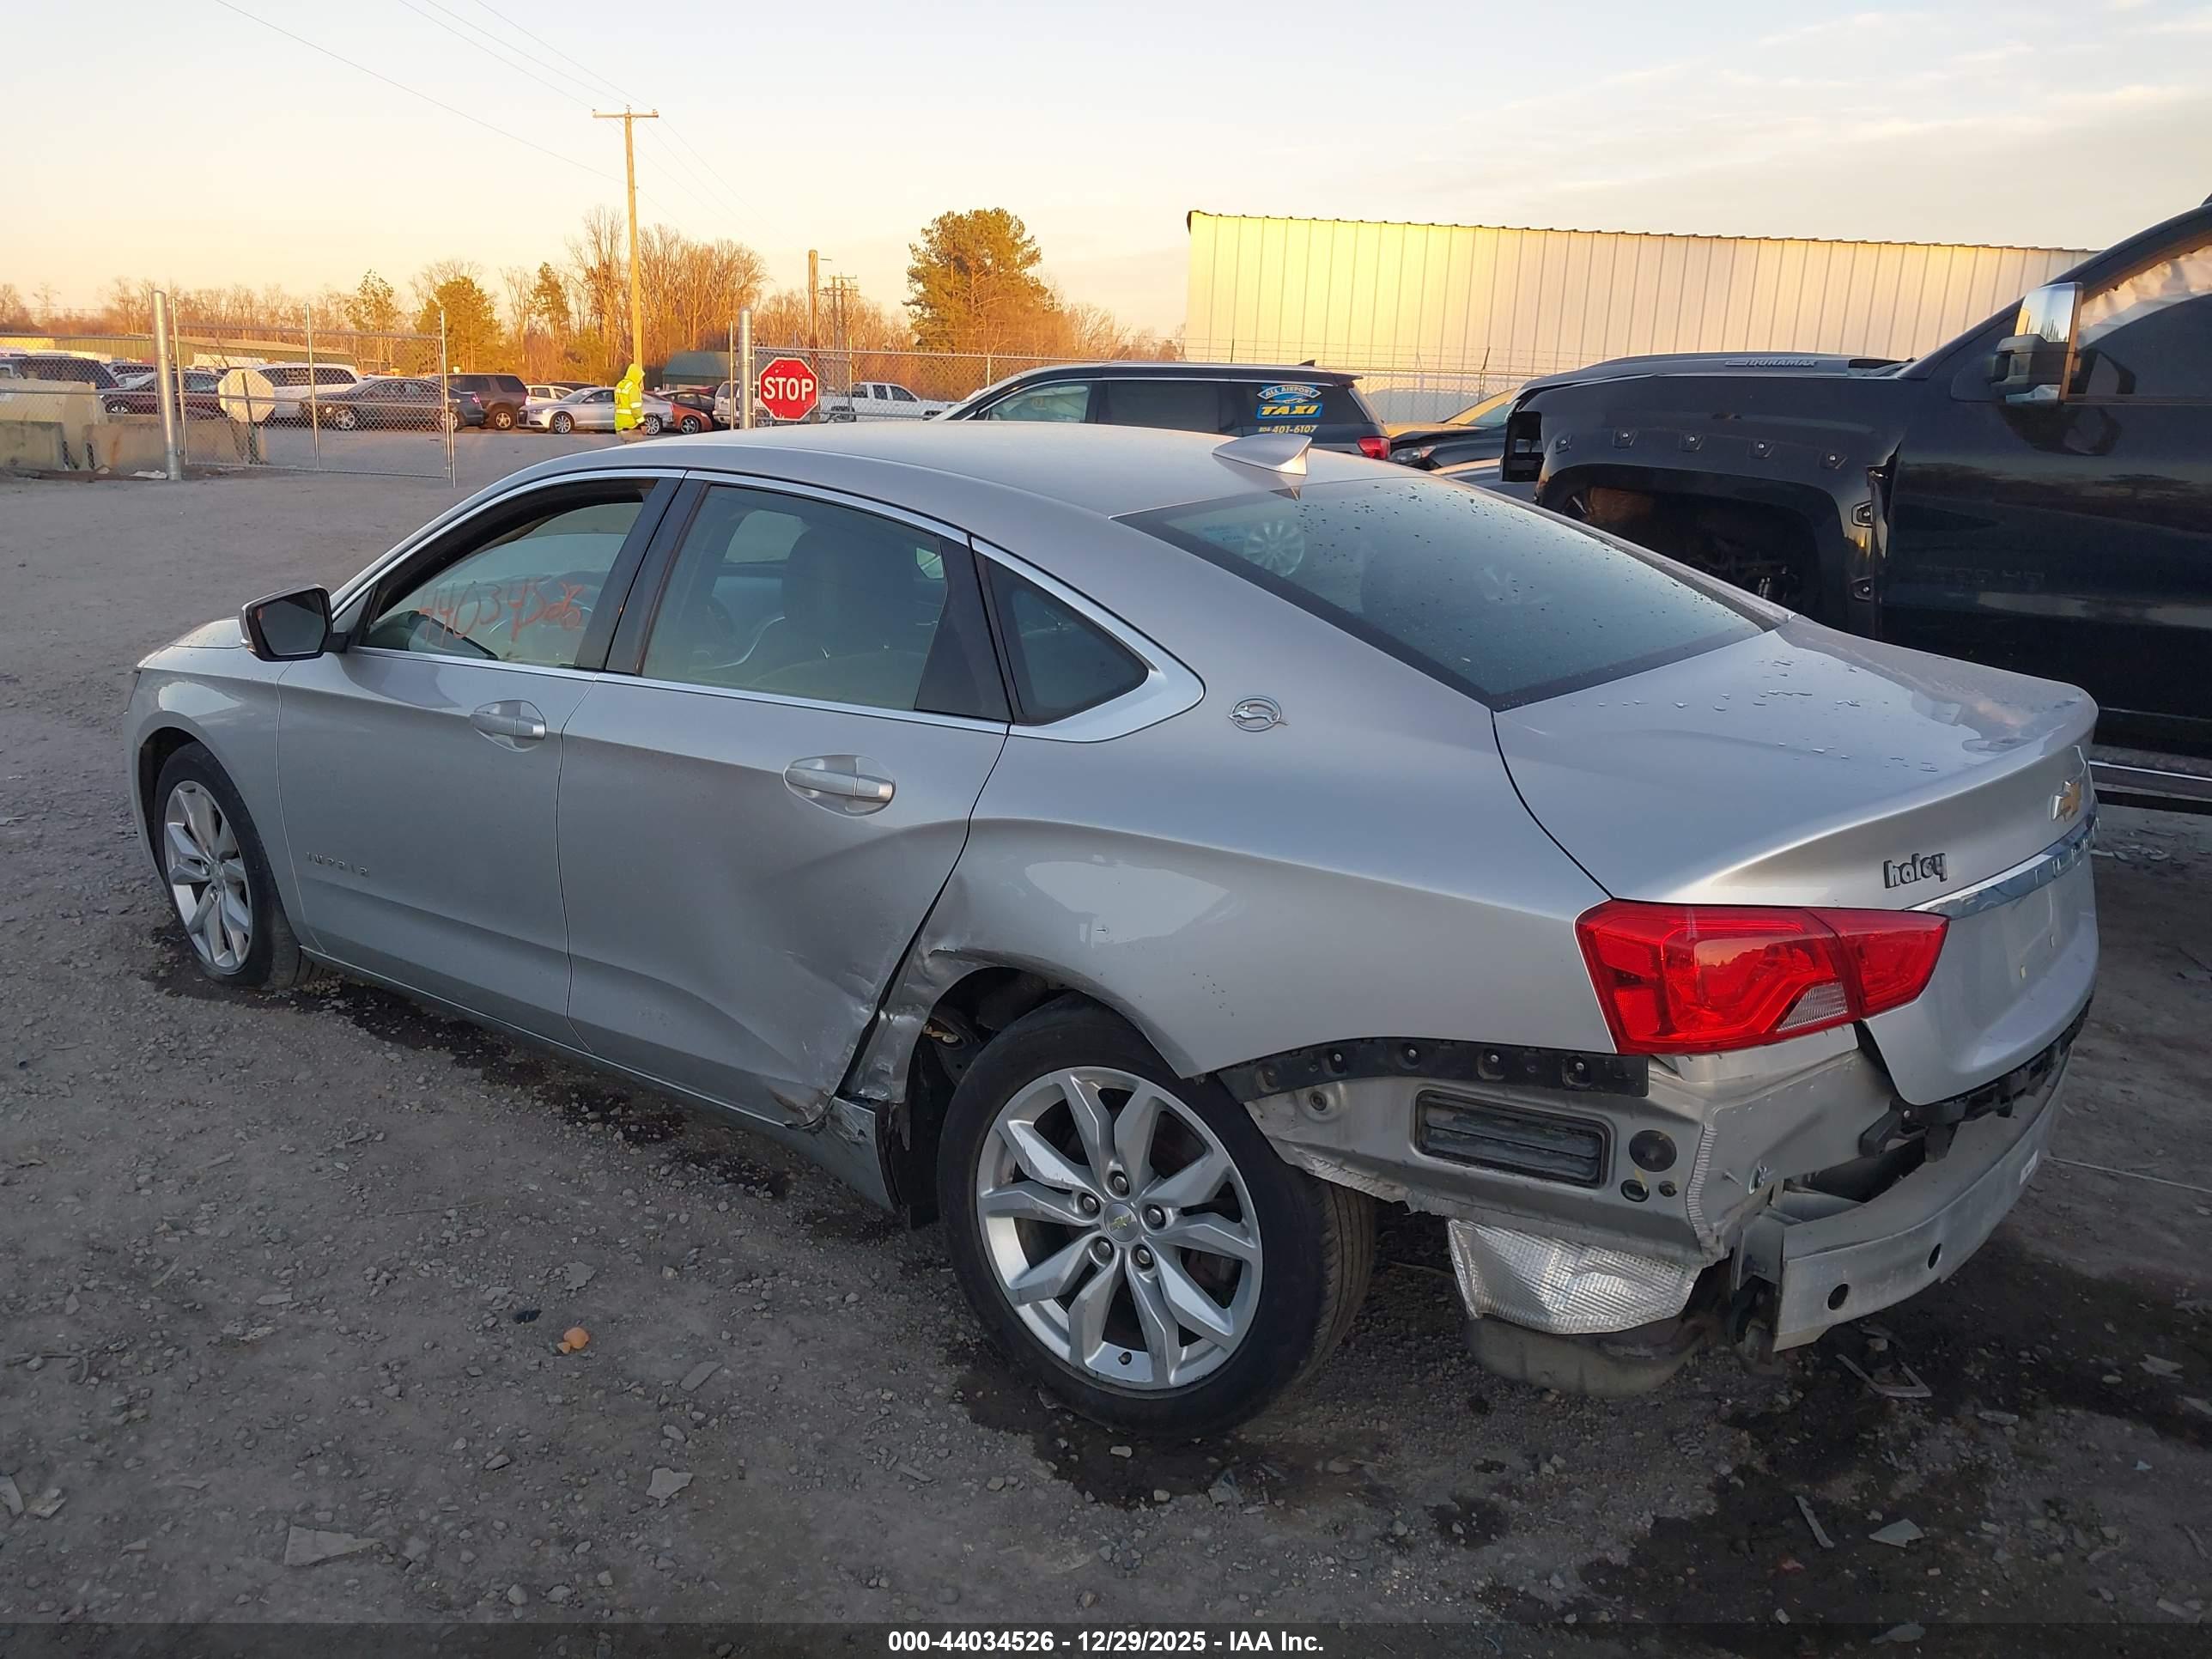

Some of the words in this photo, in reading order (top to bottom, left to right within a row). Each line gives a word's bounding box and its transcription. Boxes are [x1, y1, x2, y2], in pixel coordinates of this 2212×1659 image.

[763, 376, 814, 401] STOP
[1265, 388, 1279, 398] ALL
[1280, 386, 1314, 396] AIRPORT
[1261, 405, 1319, 416] TAXI
